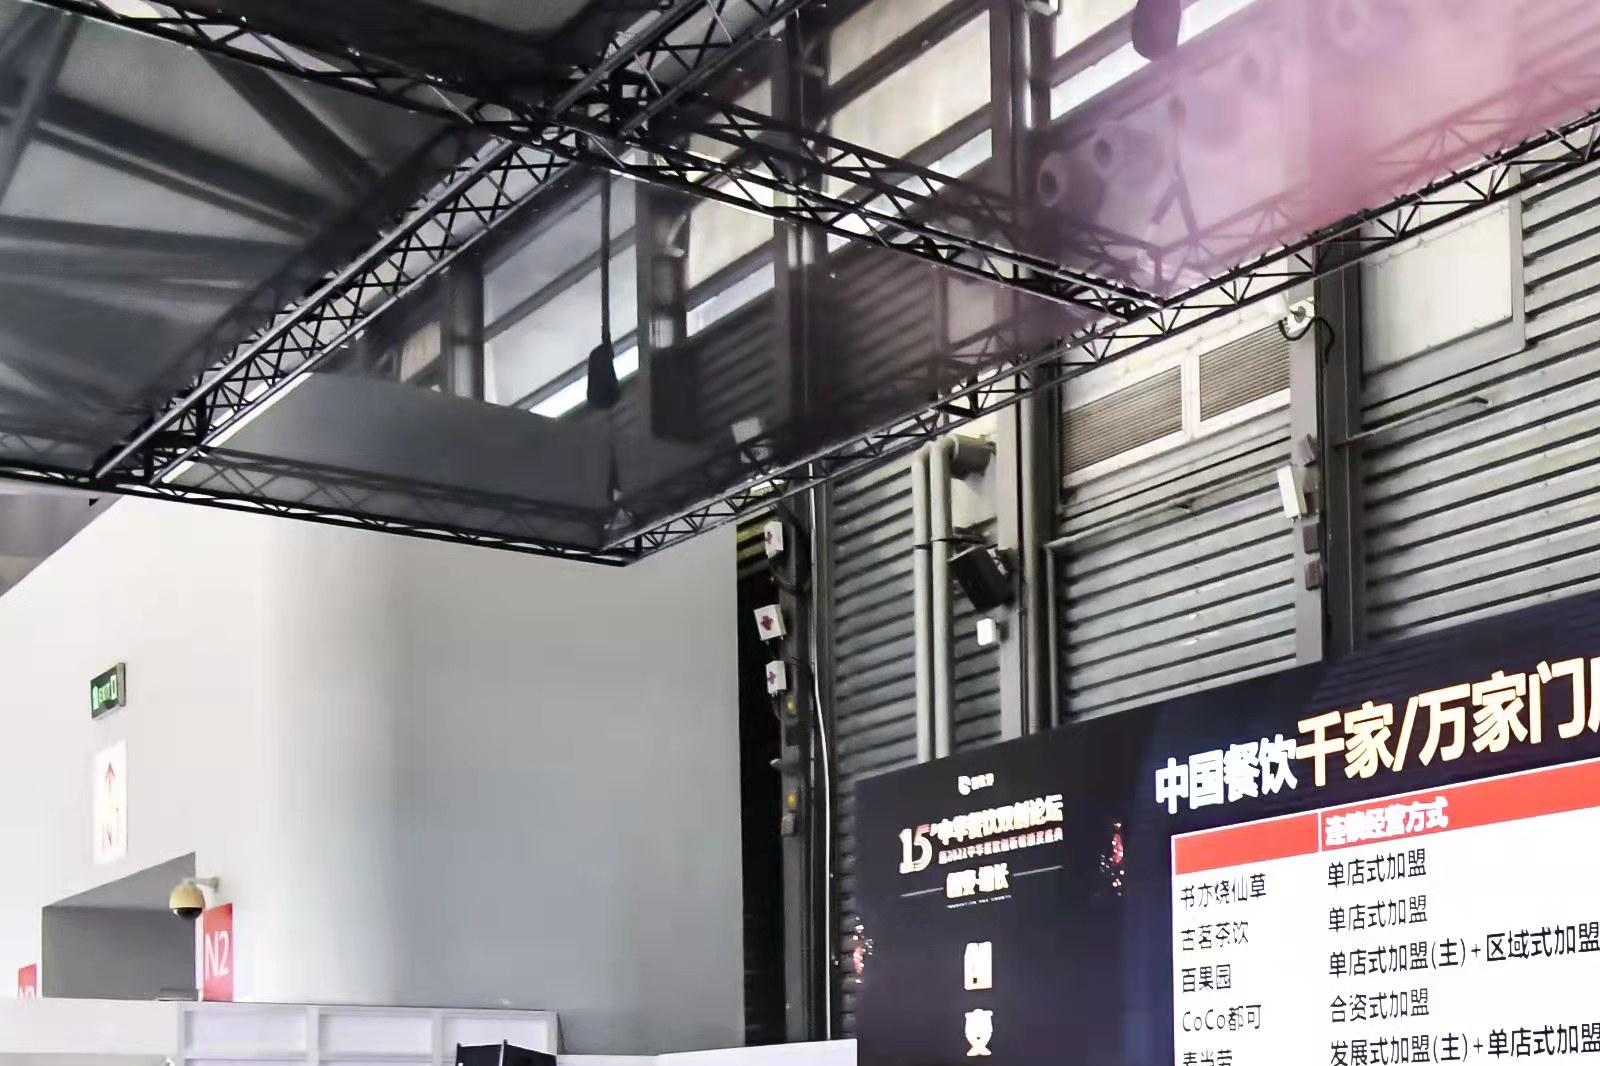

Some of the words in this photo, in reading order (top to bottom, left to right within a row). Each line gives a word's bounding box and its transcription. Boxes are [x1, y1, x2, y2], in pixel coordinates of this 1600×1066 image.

[1327, 848, 1427, 889] 单店式加盟
[1180, 873, 1267, 910] 书亦烧仙草
[1328, 895, 1428, 933] 单店式加盟
[1180, 921, 1249, 951] 古茗茶饮
[204, 930, 231, 979] N2
[1181, 964, 1232, 993] 百果园
[1182, 1004, 1262, 1032] CoCo都可
[1330, 988, 1430, 1023] 合资式加盟
